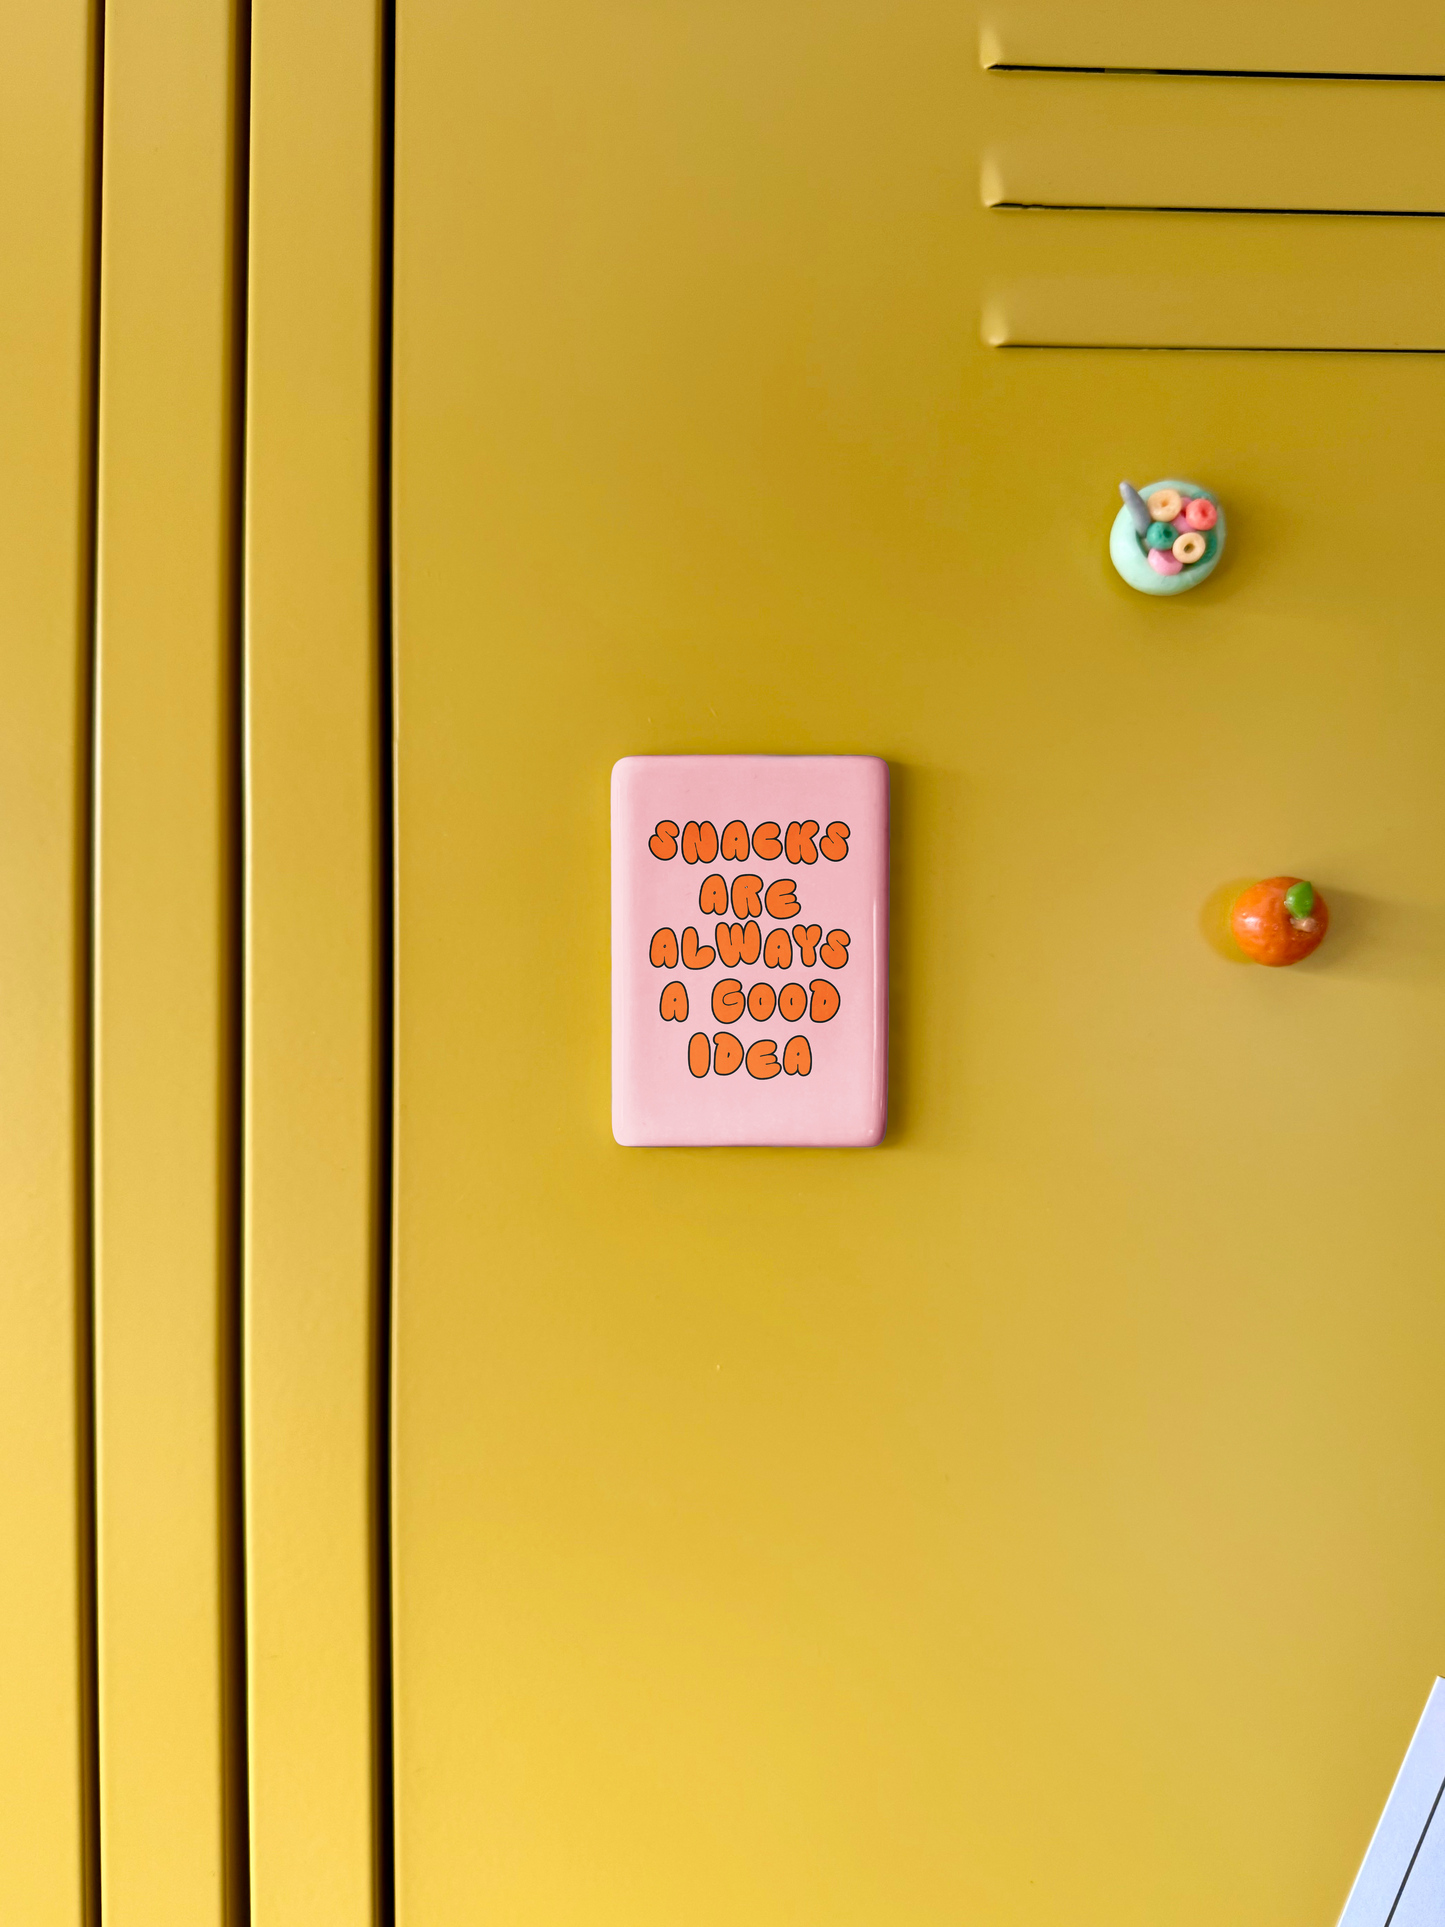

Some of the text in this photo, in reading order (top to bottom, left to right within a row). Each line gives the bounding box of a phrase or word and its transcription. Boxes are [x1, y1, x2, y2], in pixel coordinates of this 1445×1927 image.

[648, 820, 851, 865] SNACKS
[699, 874, 801, 920] ARE
[649, 920, 851, 970] ALWAYS
[659, 978, 841, 1024] A GOOD
[688, 1032, 812, 1080] IDEA
